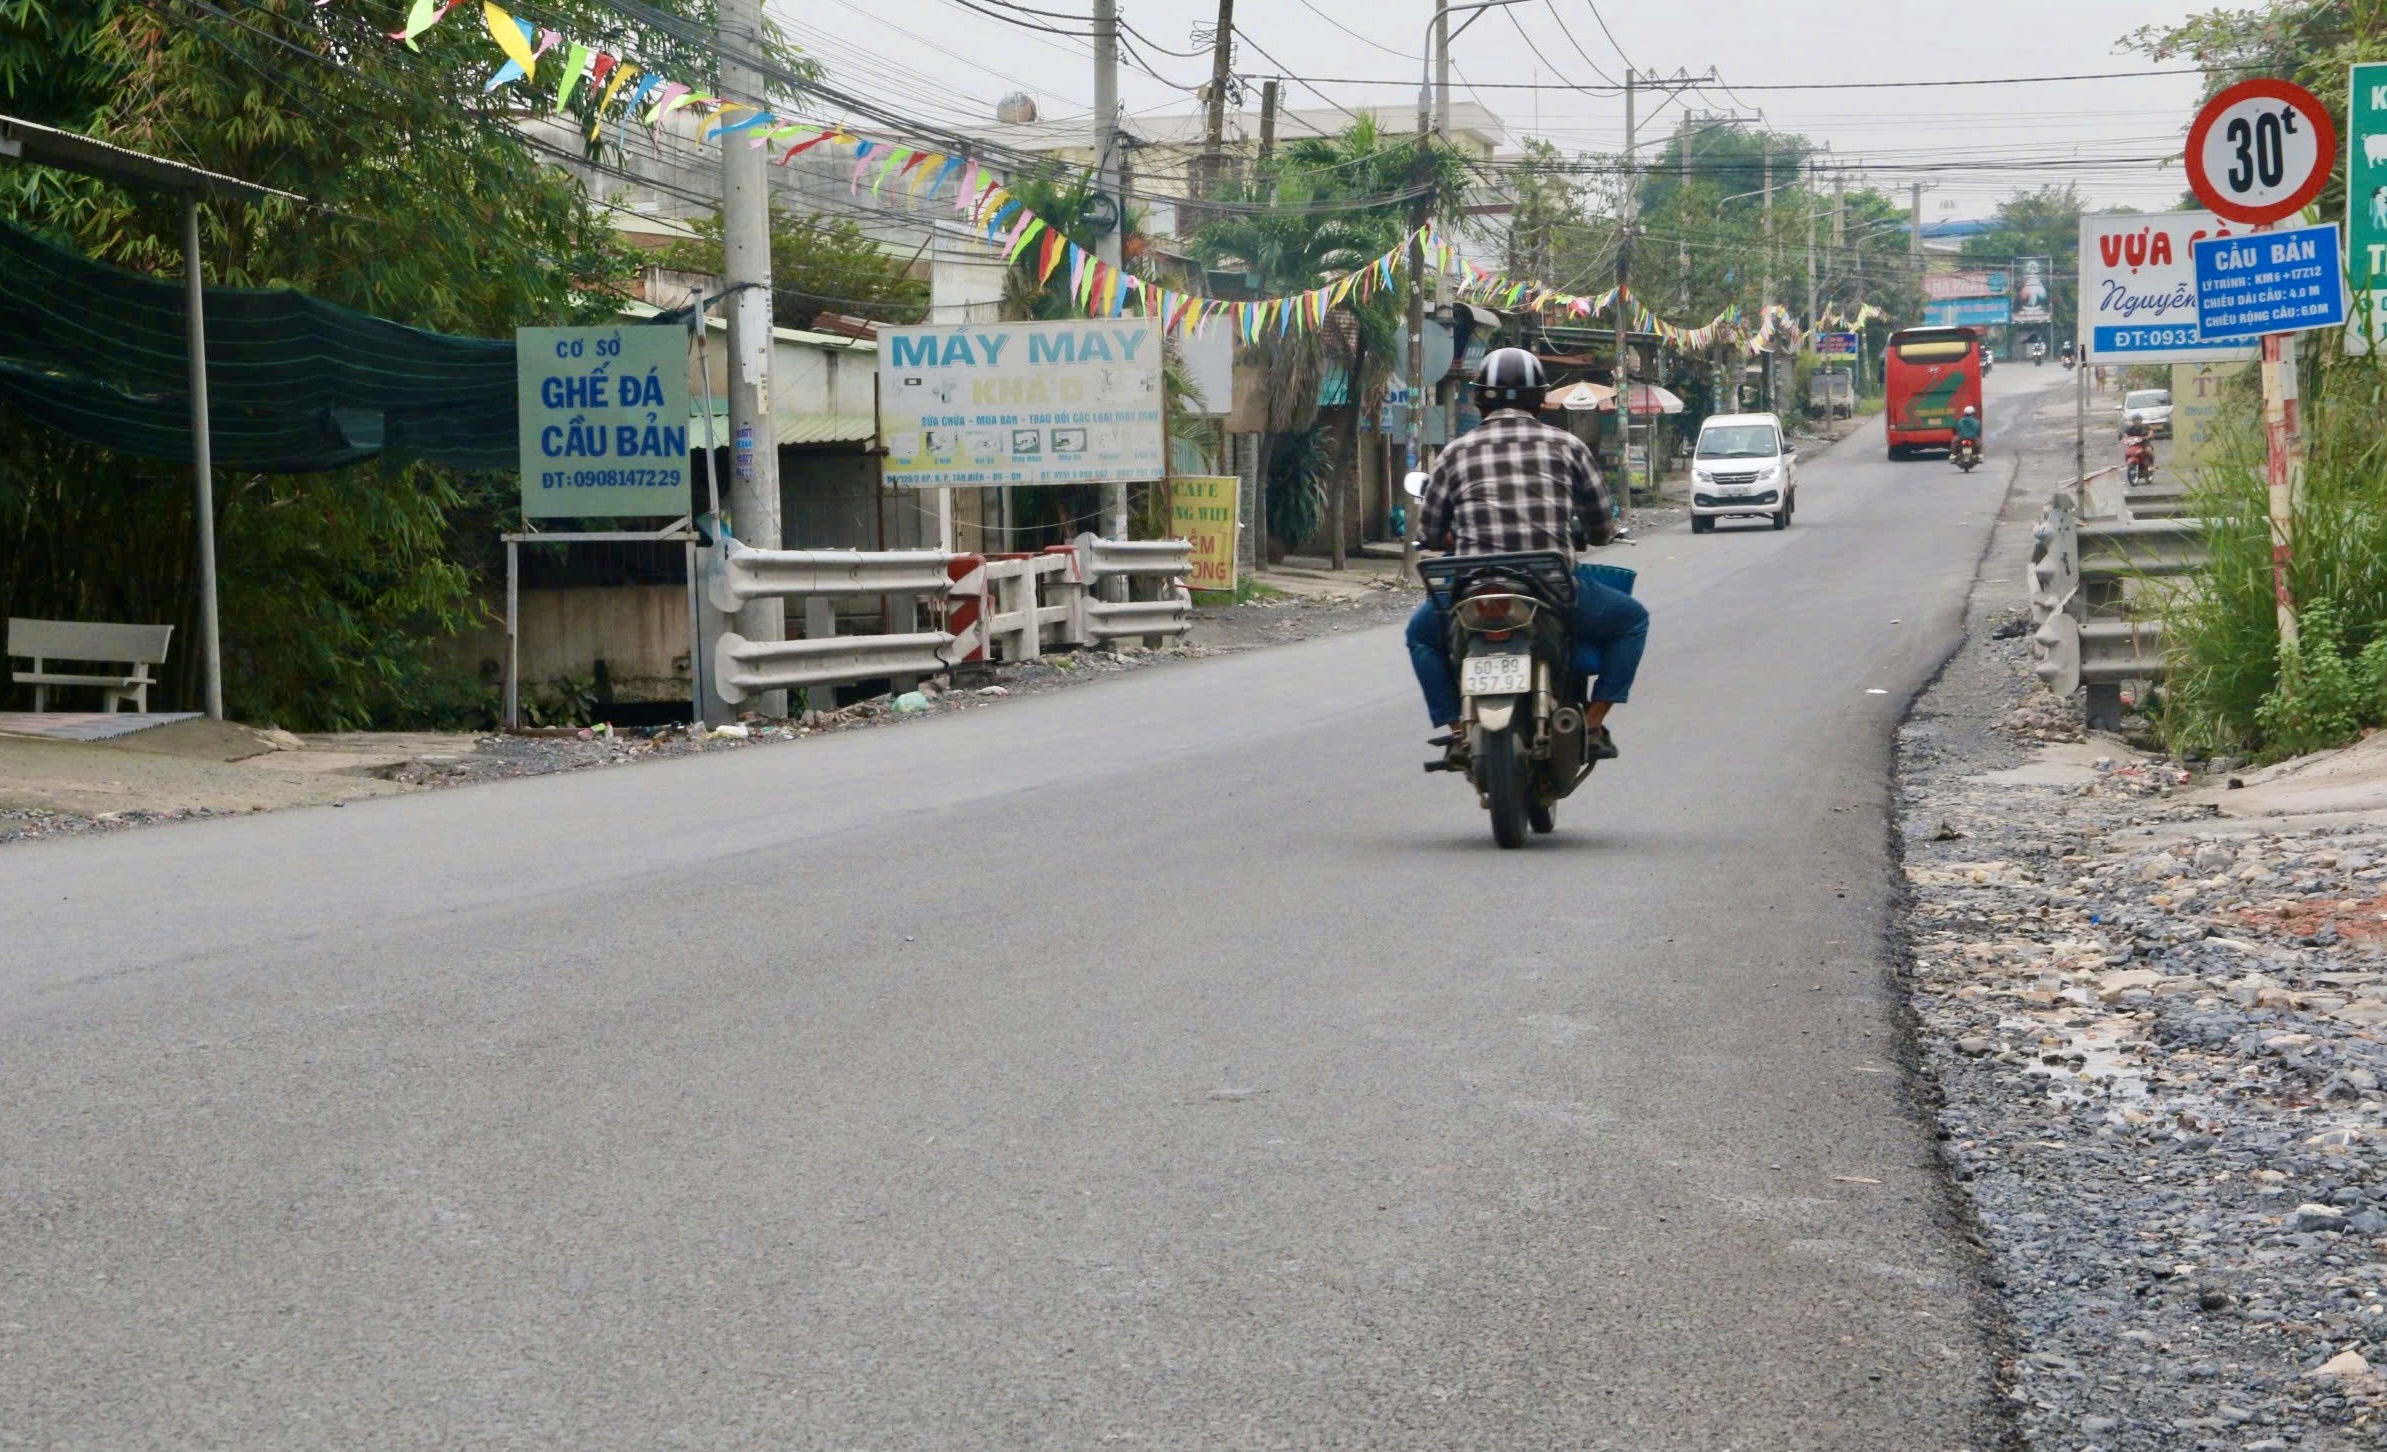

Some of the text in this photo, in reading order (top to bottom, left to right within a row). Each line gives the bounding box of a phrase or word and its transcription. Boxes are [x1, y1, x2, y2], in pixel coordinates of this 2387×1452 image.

[2100, 226, 2172, 274] VỰA
[2215, 235, 2316, 271] CẦU BẢN
[2202, 277, 2213, 292] LÝ
[2203, 293, 2235, 309] CHIỀU
[2237, 291, 2257, 306] DÀI
[2205, 311, 2237, 328] CHIỀU
[2239, 309, 2270, 326] RỘNG
[556, 329, 622, 358] CƠ SỞ
[892, 328, 1149, 368] MÁY MAY
[541, 361, 664, 409] GHẾ ĐÁ
[976, 415, 997, 425] MUA
[1029, 414, 1051, 424] TRAO
[541, 412, 686, 458] CẦU BẢN
[1198, 507, 1228, 520] WIFI
